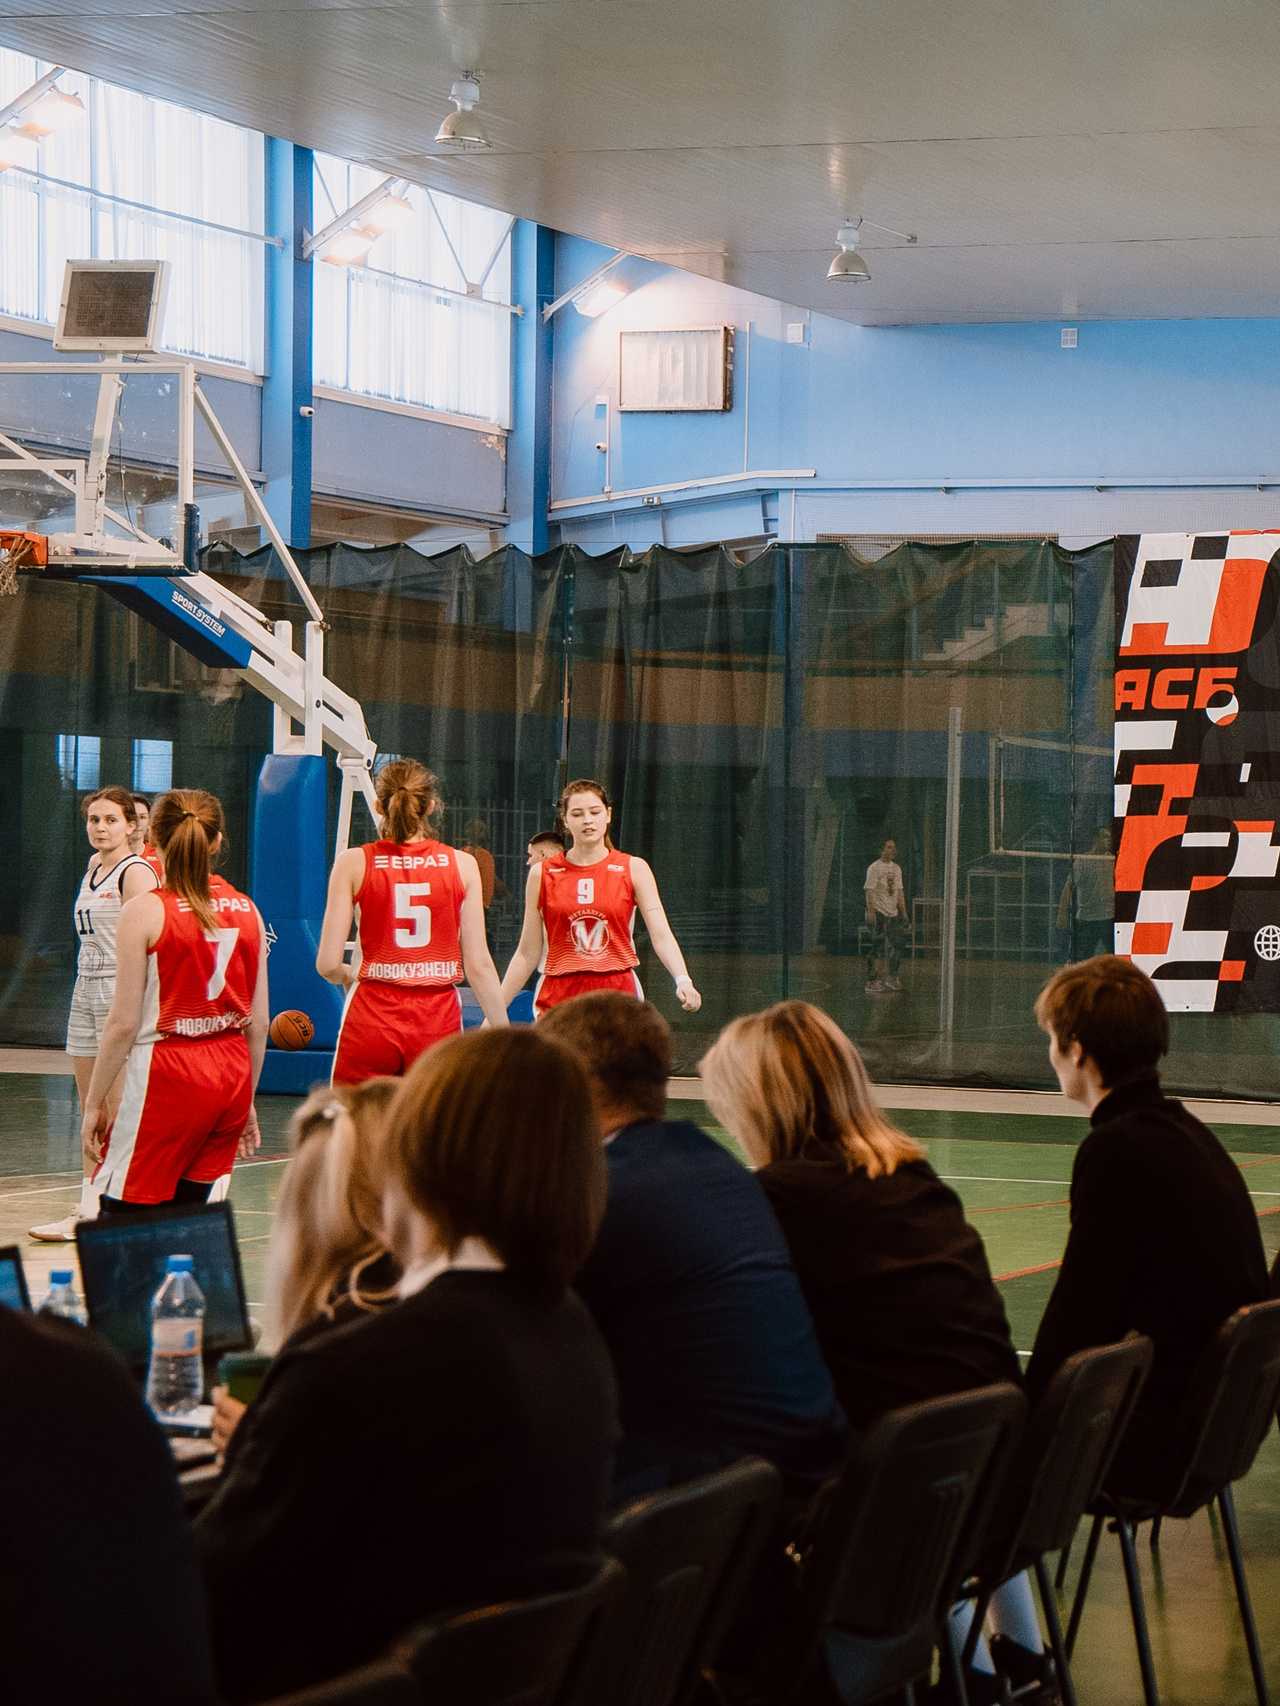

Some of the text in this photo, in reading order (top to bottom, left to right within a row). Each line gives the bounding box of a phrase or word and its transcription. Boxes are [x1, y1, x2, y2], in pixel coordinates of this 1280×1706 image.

[172, 590, 226, 636] SPORT SYSTEM
[391, 854, 450, 870] ЕВРАЗ
[577, 877, 595, 905] 9
[208, 897, 251, 913] ВРАЗ
[394, 882, 432, 949] 5
[77, 908, 95, 935] 11
[204, 927, 241, 1001] 7
[367, 960, 459, 980] НОВОКУЗНЕЦК
